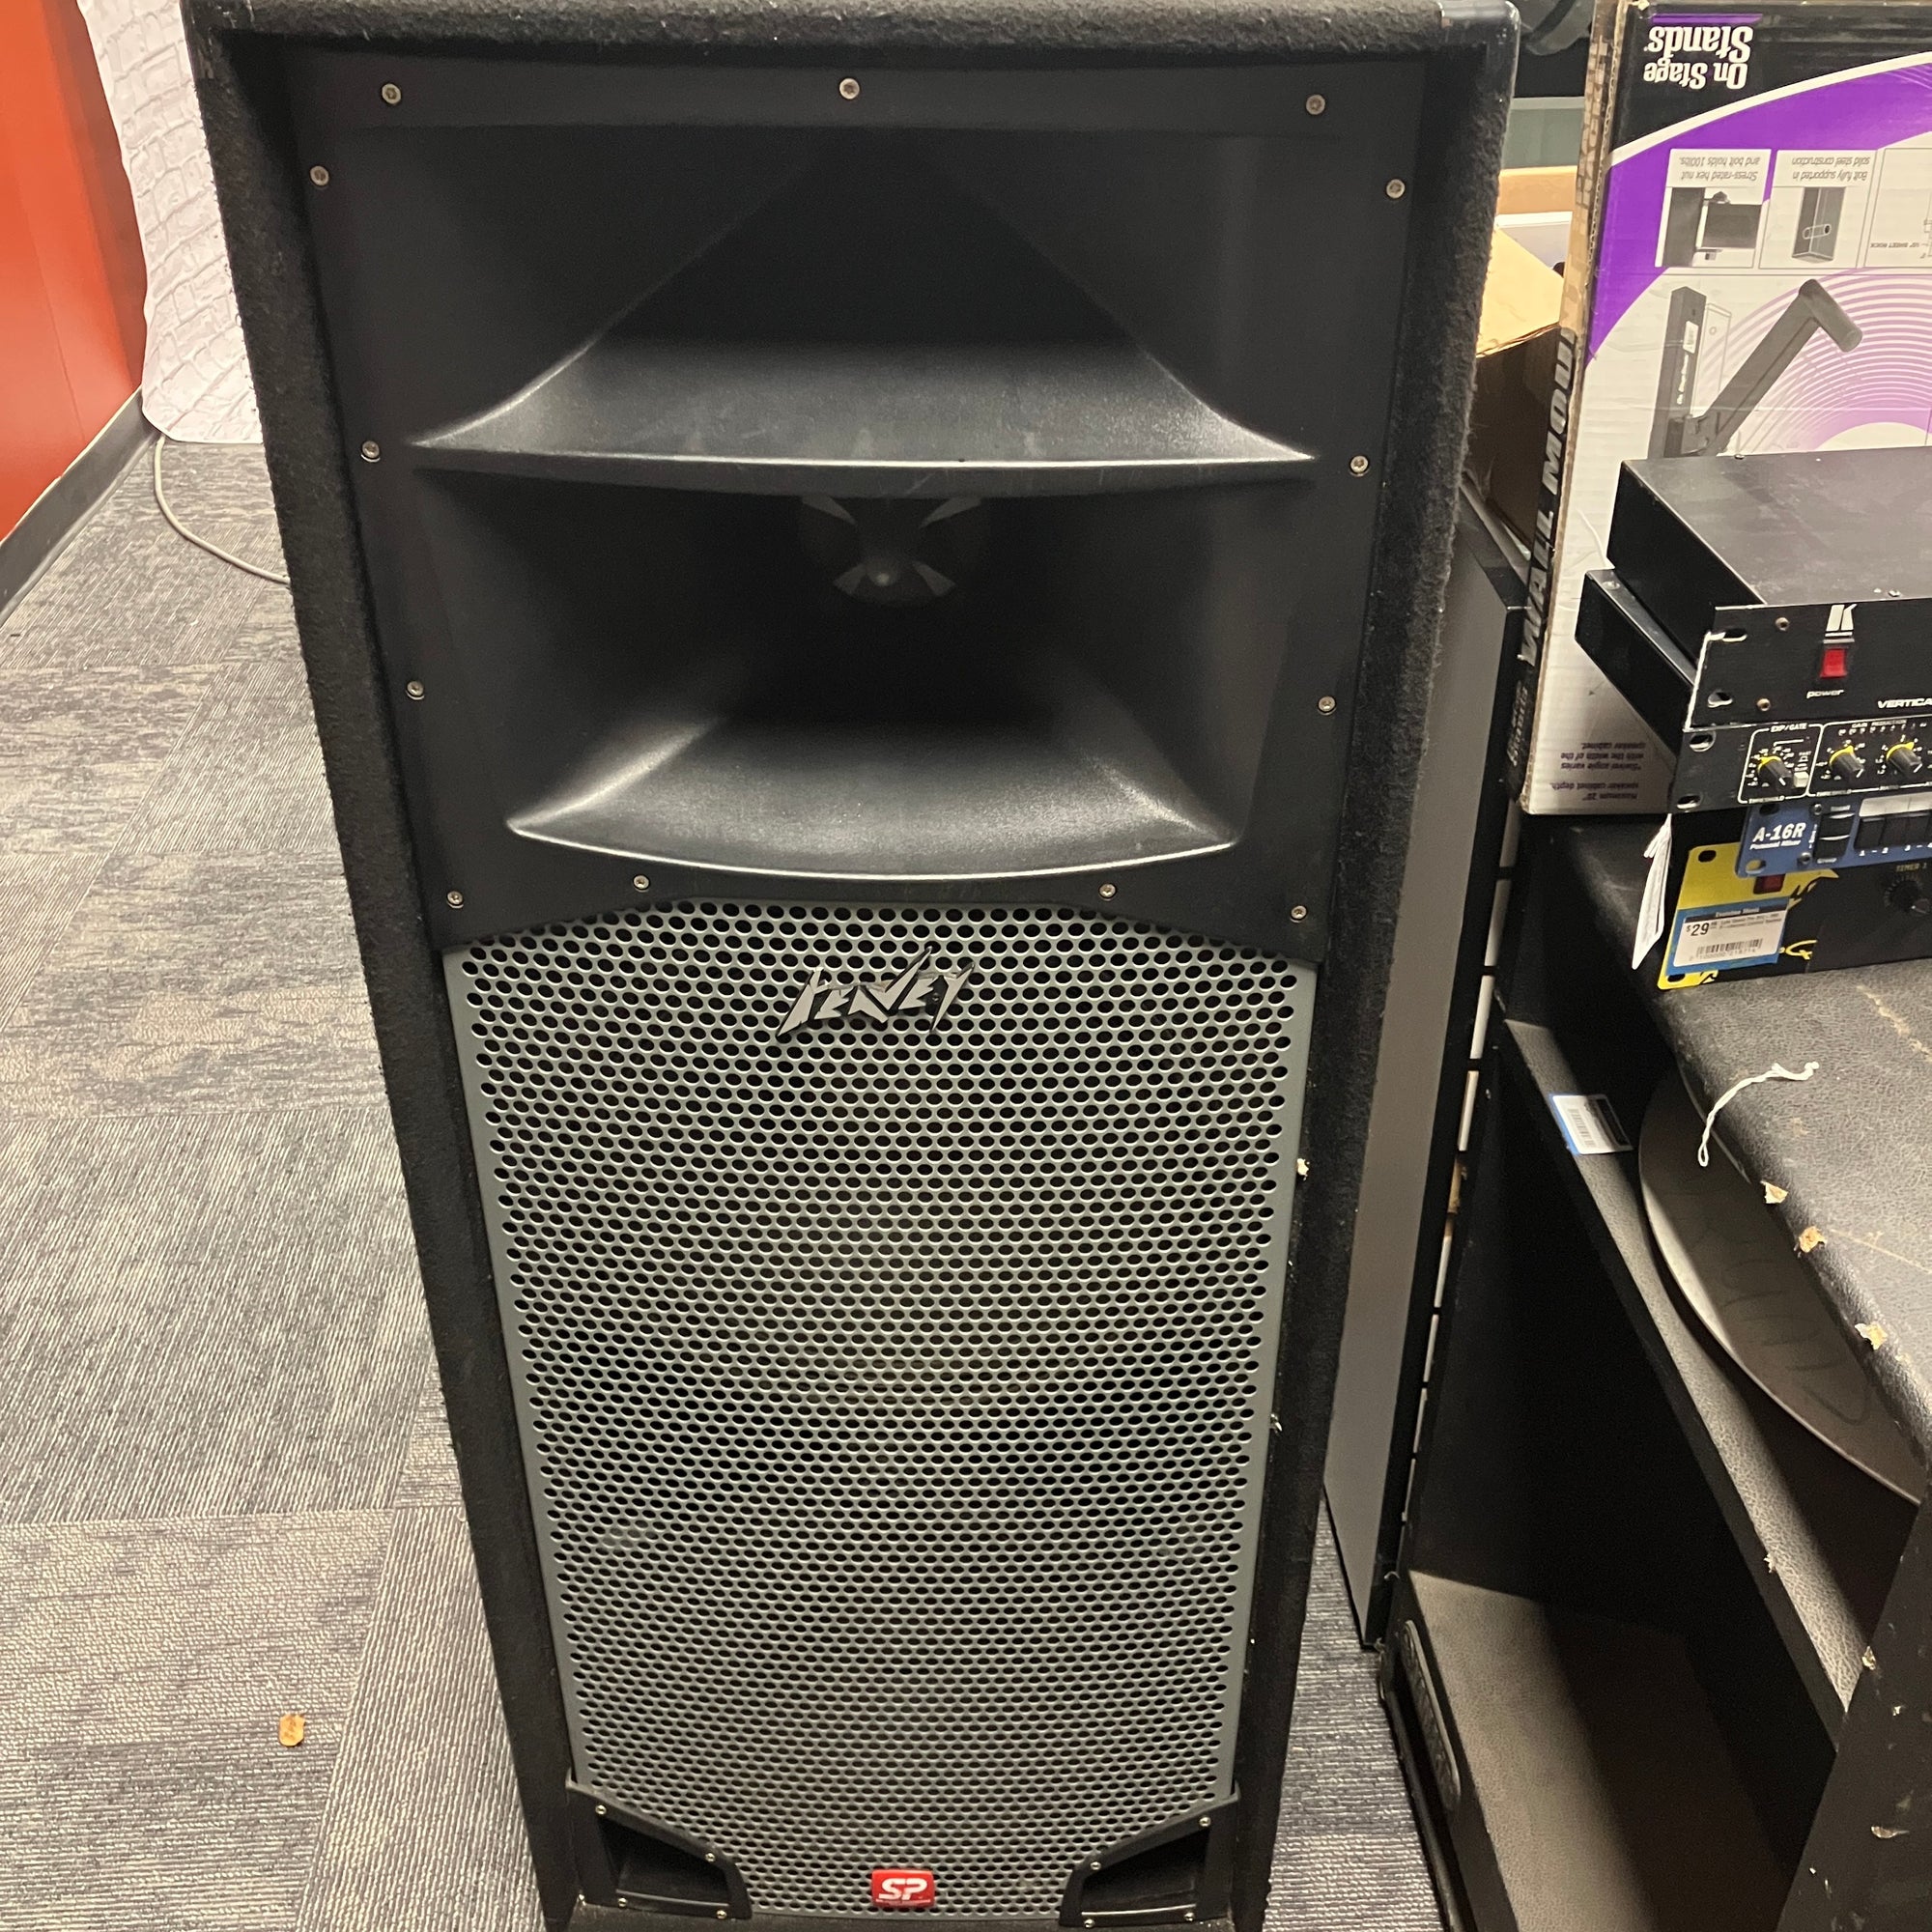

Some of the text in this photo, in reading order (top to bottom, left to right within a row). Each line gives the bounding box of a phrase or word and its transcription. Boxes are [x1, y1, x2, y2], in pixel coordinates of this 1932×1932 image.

[1645, 25, 1755, 63] Stands
[1643, 56, 1748, 90] On Stage
[1707, 156, 1728, 166] holds
[1730, 156, 1745, 166] bolt
[1746, 156, 1761, 166] and
[1792, 156, 1871, 166] solid steel construction
[1681, 171, 1758, 181] Stress-rated hex nut
[1793, 169, 1868, 181] Bolt fully supported in
[1517, 509, 1553, 667] WALL
[1806, 689, 1844, 699] power
[1752, 822, 1806, 843] A-16R
[776, 945, 975, 1037] PEAVEY
[878, 1877, 927, 1901] SP
